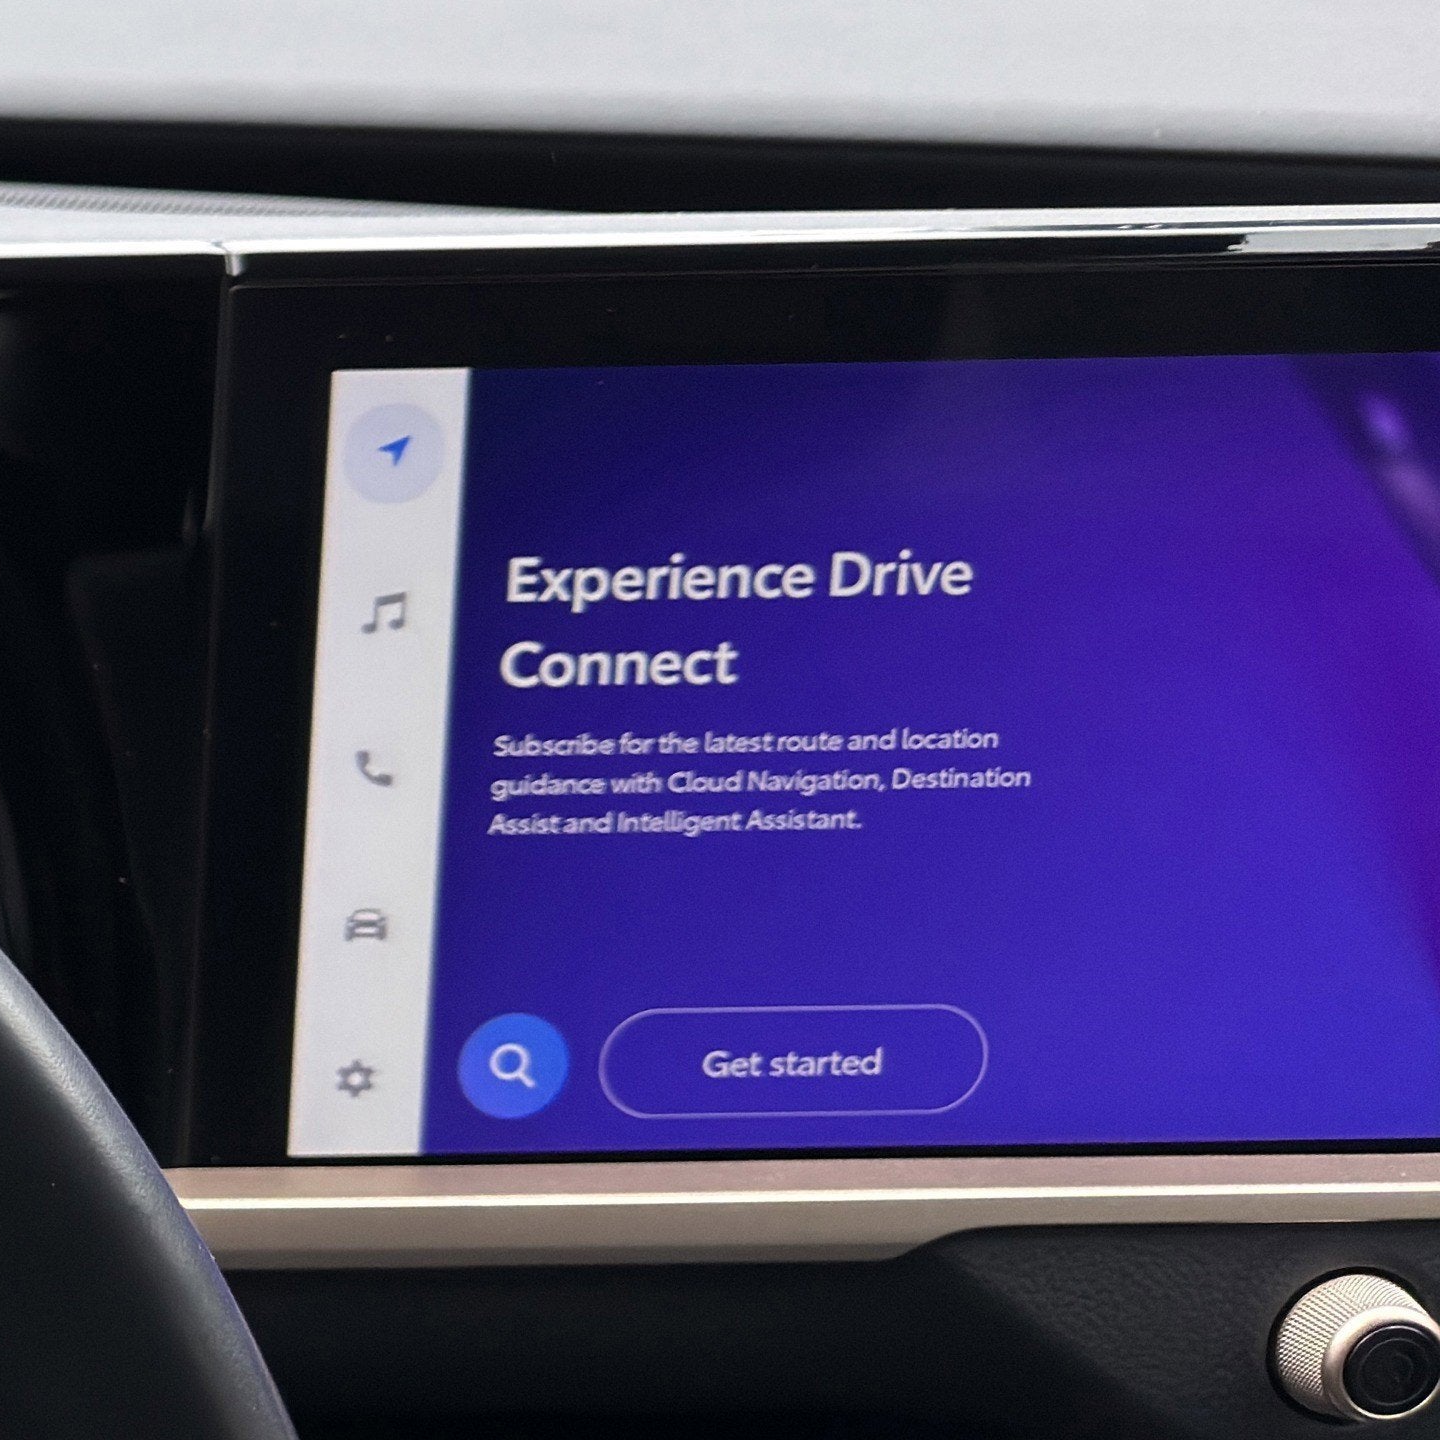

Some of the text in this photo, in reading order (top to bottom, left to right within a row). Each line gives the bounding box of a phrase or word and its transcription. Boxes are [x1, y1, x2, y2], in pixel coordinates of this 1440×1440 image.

[506, 548, 974, 613] Experience Drive
[499, 639, 740, 688] Connect
[493, 727, 1000, 757] Subscribe for the latest route and location
[490, 766, 1031, 802] guidance with Cloud Navigation, Destination
[487, 809, 862, 838] Assist and Intelligent Assistant.
[702, 1046, 883, 1080] Get started
